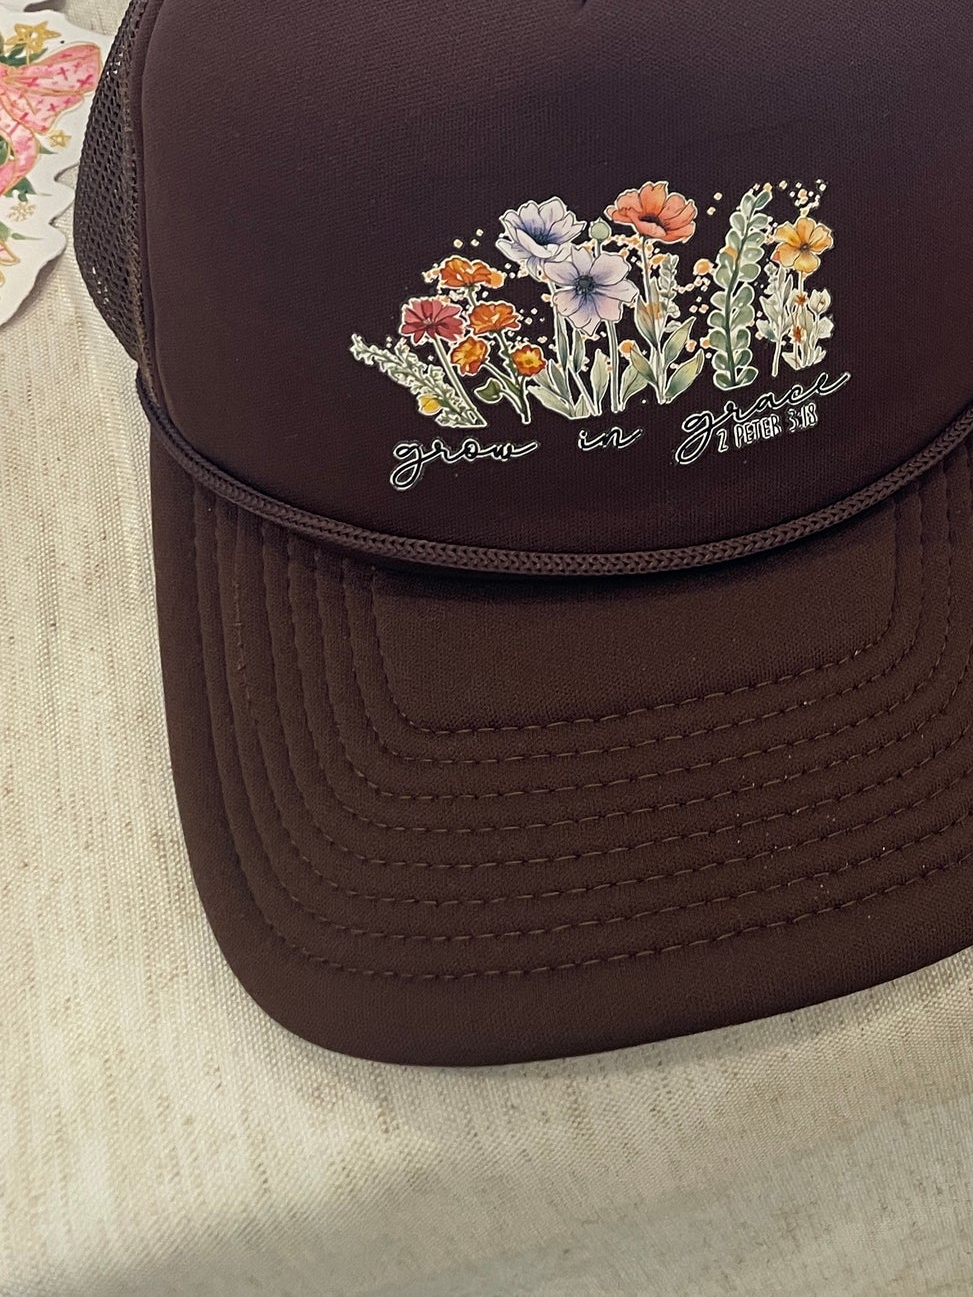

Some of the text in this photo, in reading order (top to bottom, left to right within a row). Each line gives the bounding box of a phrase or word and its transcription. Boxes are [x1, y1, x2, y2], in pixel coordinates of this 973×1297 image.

[388, 371, 852, 491] grow in grace
[715, 402, 819, 453] 2 PETER 3:18
